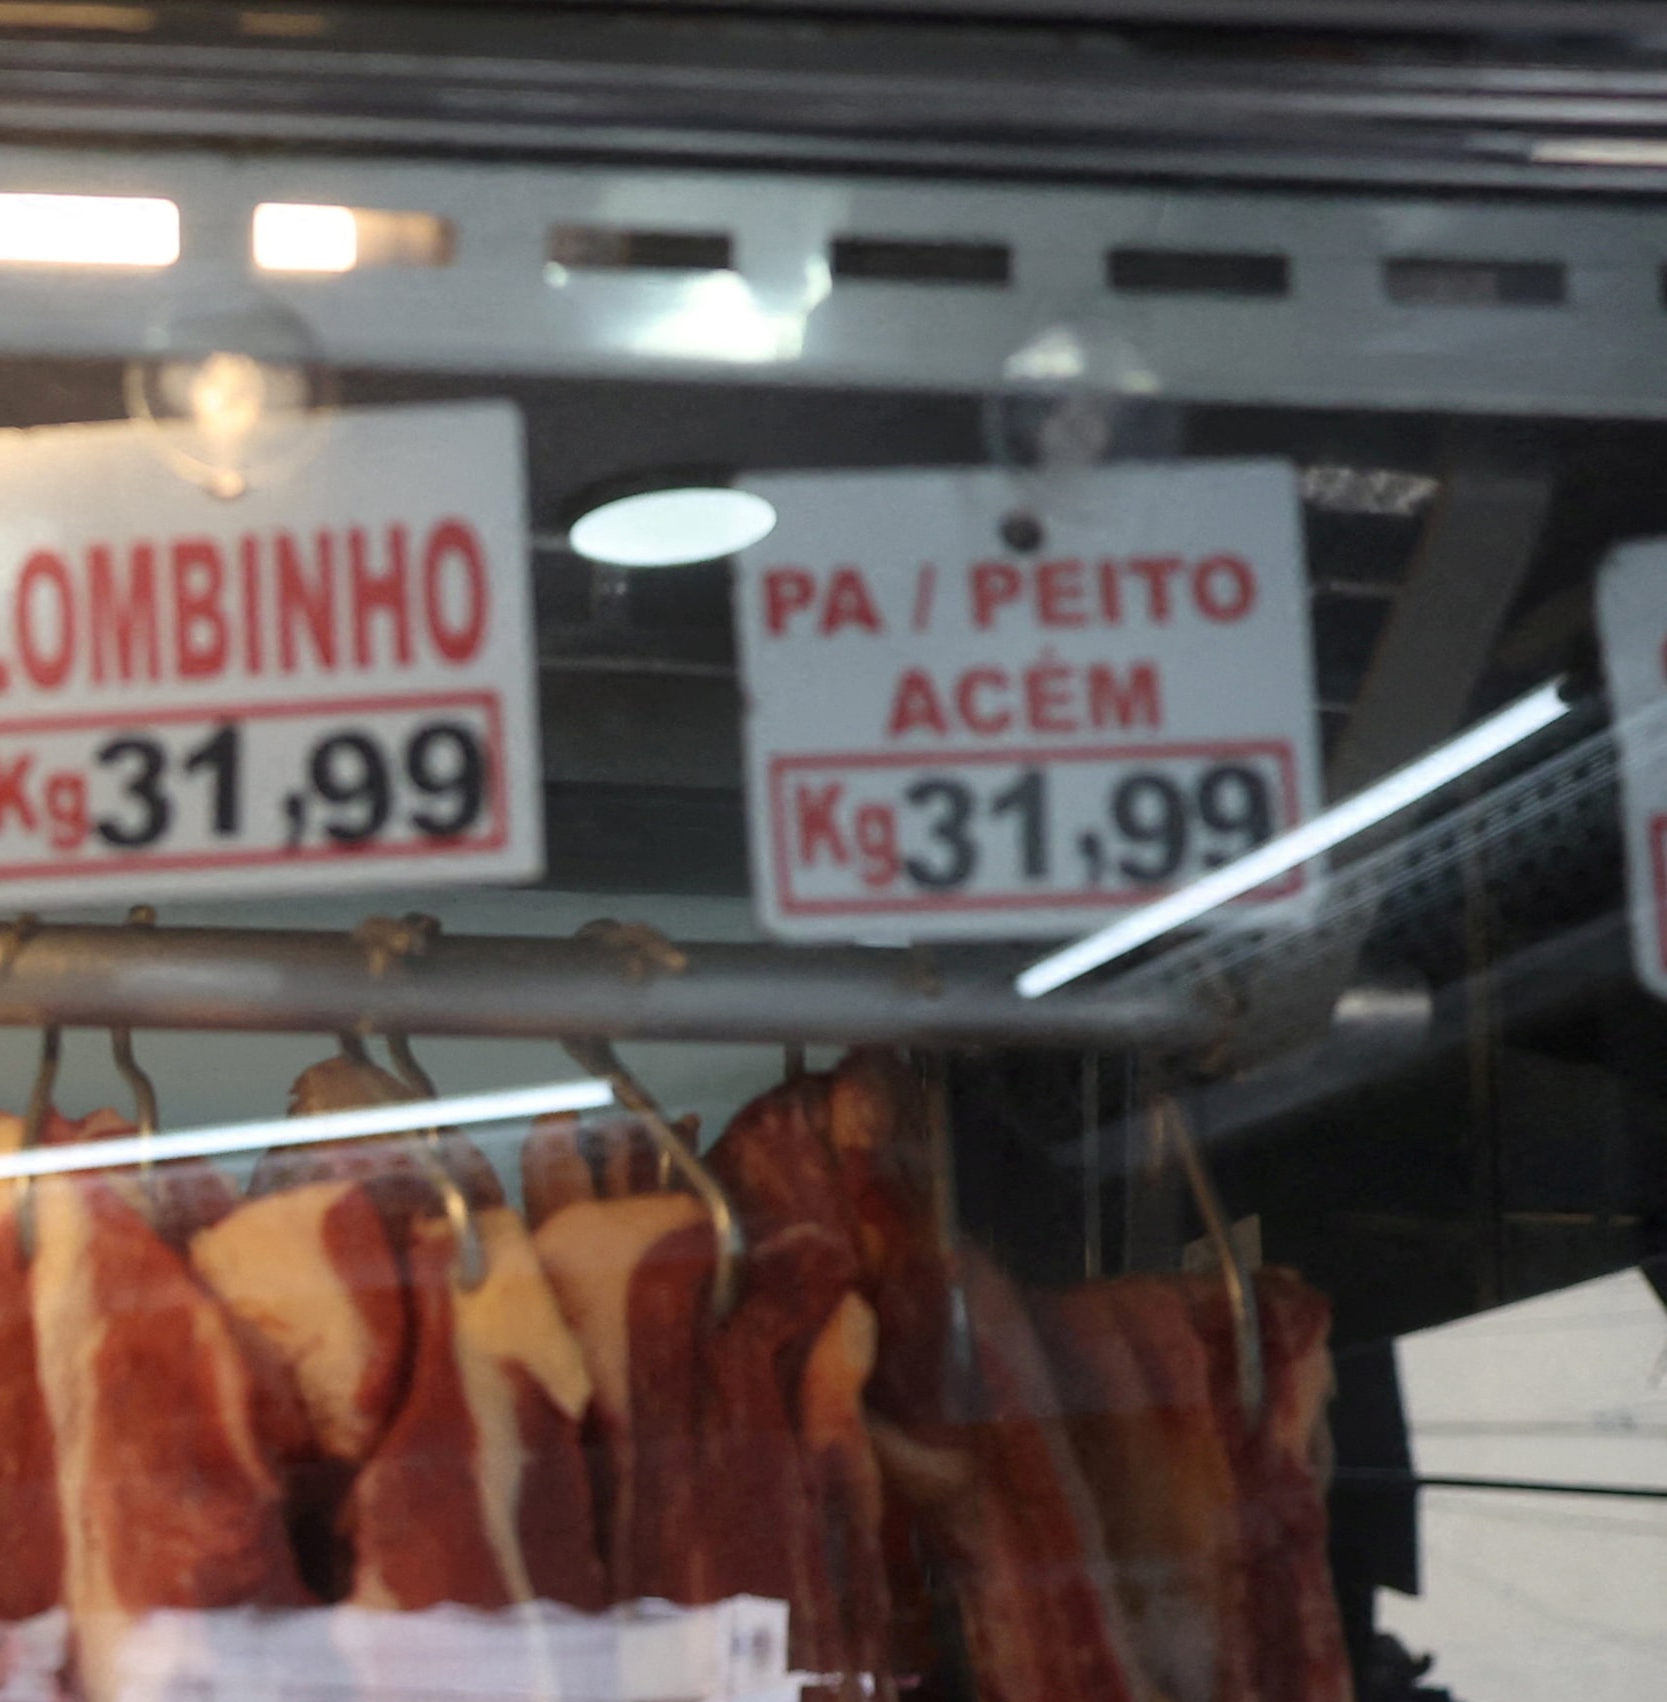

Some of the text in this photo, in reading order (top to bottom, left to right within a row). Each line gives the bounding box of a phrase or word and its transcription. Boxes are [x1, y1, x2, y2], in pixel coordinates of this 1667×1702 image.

[763, 553, 1257, 640] PA / PEITO
[887, 648, 1161, 738] ACÉM
